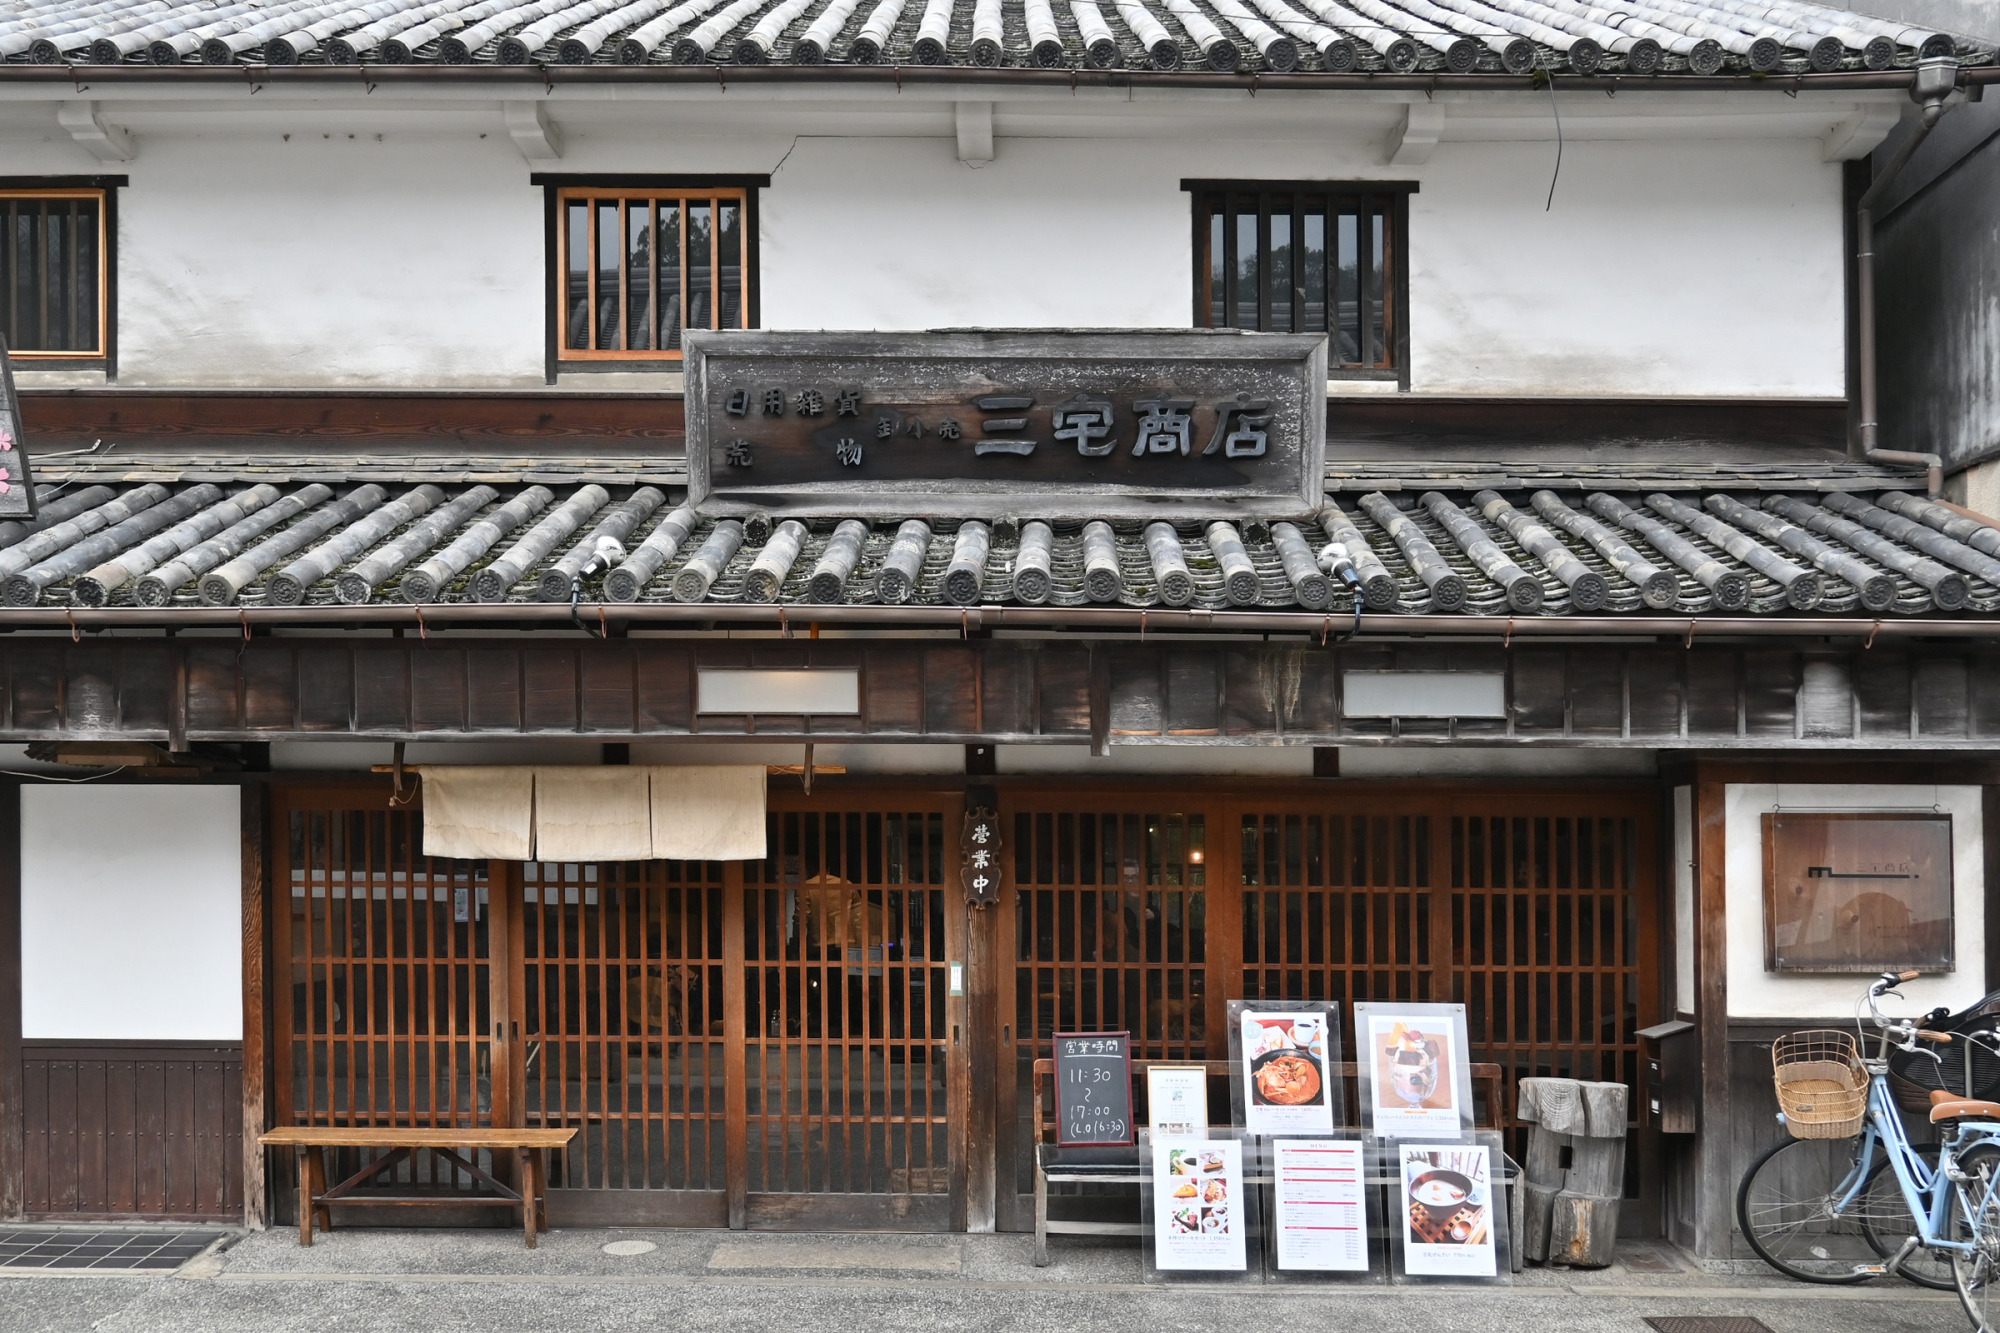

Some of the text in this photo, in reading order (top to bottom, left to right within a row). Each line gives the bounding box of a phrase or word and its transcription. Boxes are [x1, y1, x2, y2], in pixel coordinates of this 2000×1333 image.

[972, 393, 1275, 458] 三宅商店
[1065, 1039, 1118, 1055] 営業時間
[1070, 1067, 1111, 1084] 11:30
[1070, 1105, 1111, 1120] 17:00
